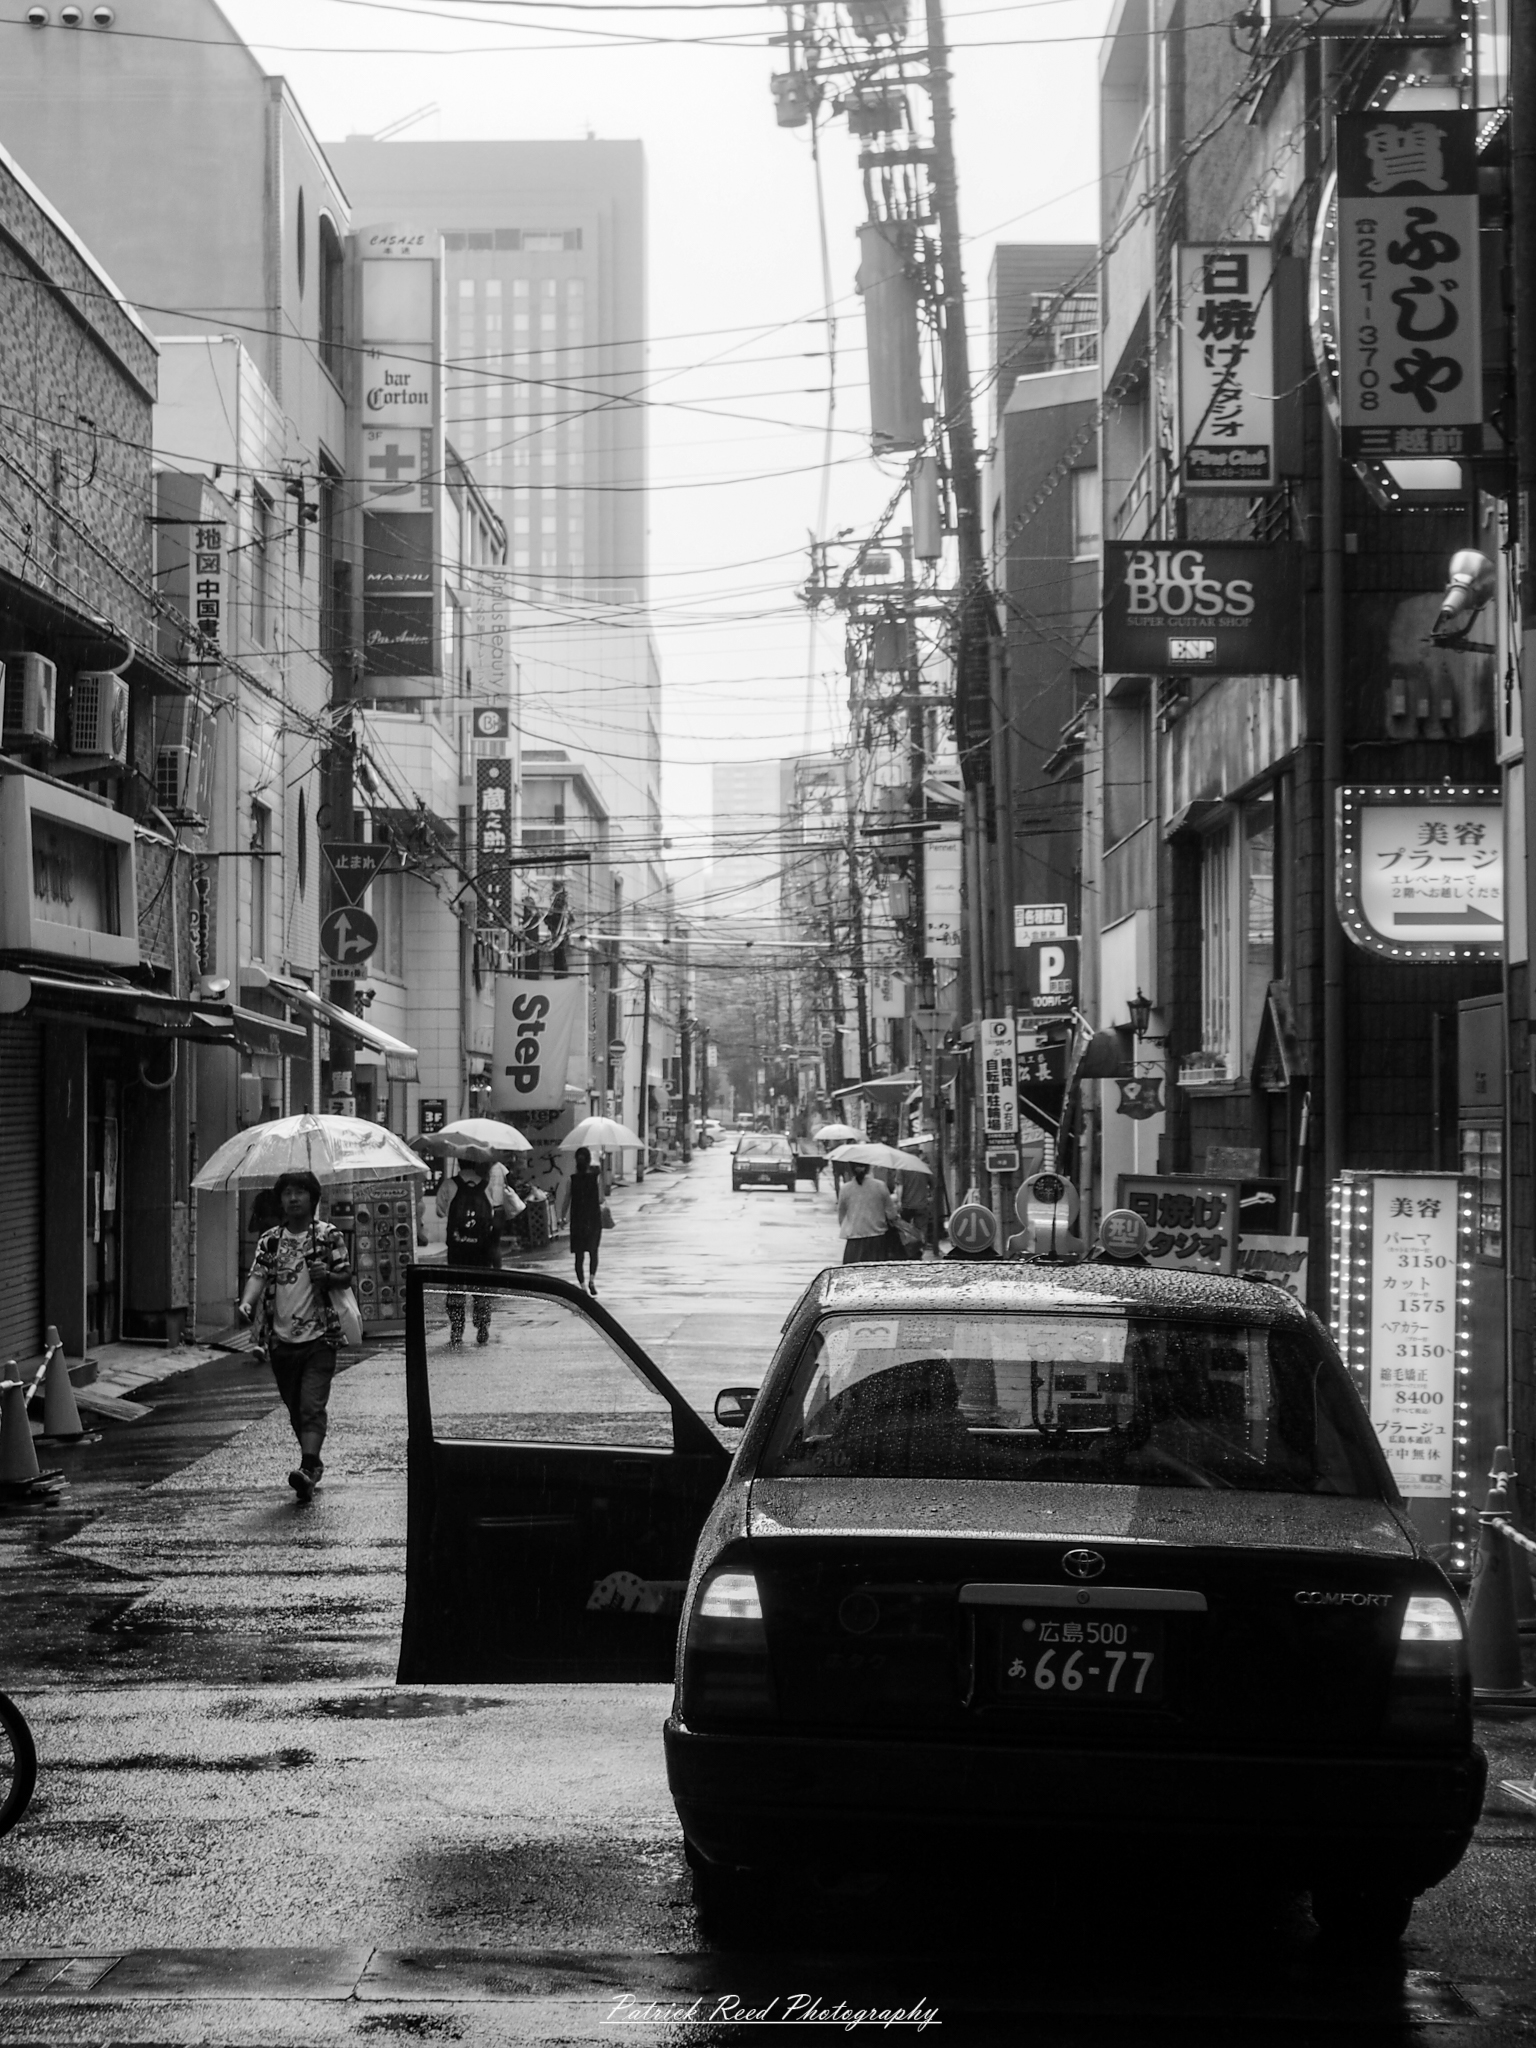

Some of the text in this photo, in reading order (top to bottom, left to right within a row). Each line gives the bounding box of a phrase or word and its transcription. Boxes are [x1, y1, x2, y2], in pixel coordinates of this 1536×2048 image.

[369, 235, 425, 246] CASALE
[1388, 206, 1463, 413] ふじや
[1357, 239, 1380, 411] 221-3708
[1197, 254, 1256, 437] 日焼けスタジオ
[384, 370, 411, 386] bar
[367, 388, 429, 411] Corton
[367, 431, 383, 441] 3F
[1359, 427, 1463, 454] 三越前
[196, 528, 221, 575] 地図
[1124, 550, 1206, 585] BIG
[1127, 580, 1256, 616] BOSS
[1127, 617, 1252, 627] SUPER GUITAR SHOP
[1170, 639, 1215, 659] ESP
[1418, 821, 1486, 846] 美容
[335, 854, 377, 869] 止まれ
[1376, 847, 1499, 871] プラージ
[1391, 875, 1477, 885] エレベーターで
[1039, 946, 1065, 994] P
[505, 993, 550, 1094] Step
[425, 1111, 443, 1122] 3F
[1129, 1192, 1228, 1230] 日焼け
[1390, 1197, 1442, 1218] 美容
[957, 1212, 990, 1242] 小
[1108, 1218, 1139, 1249] 型
[1143, 1231, 1228, 1261] タジオ
[1384, 1232, 1431, 1246] パーマ
[1383, 1276, 1430, 1290] カット
[1398, 1300, 1446, 1313] 1575
[1380, 1321, 1430, 1334] ヘアカラー
[1395, 1391, 1444, 1405] 8400
[1376, 1420, 1447, 1435] プラージュ
[1294, 1591, 1393, 1606] COMFORT
[1008, 1648, 1155, 1694] あ 66-77
